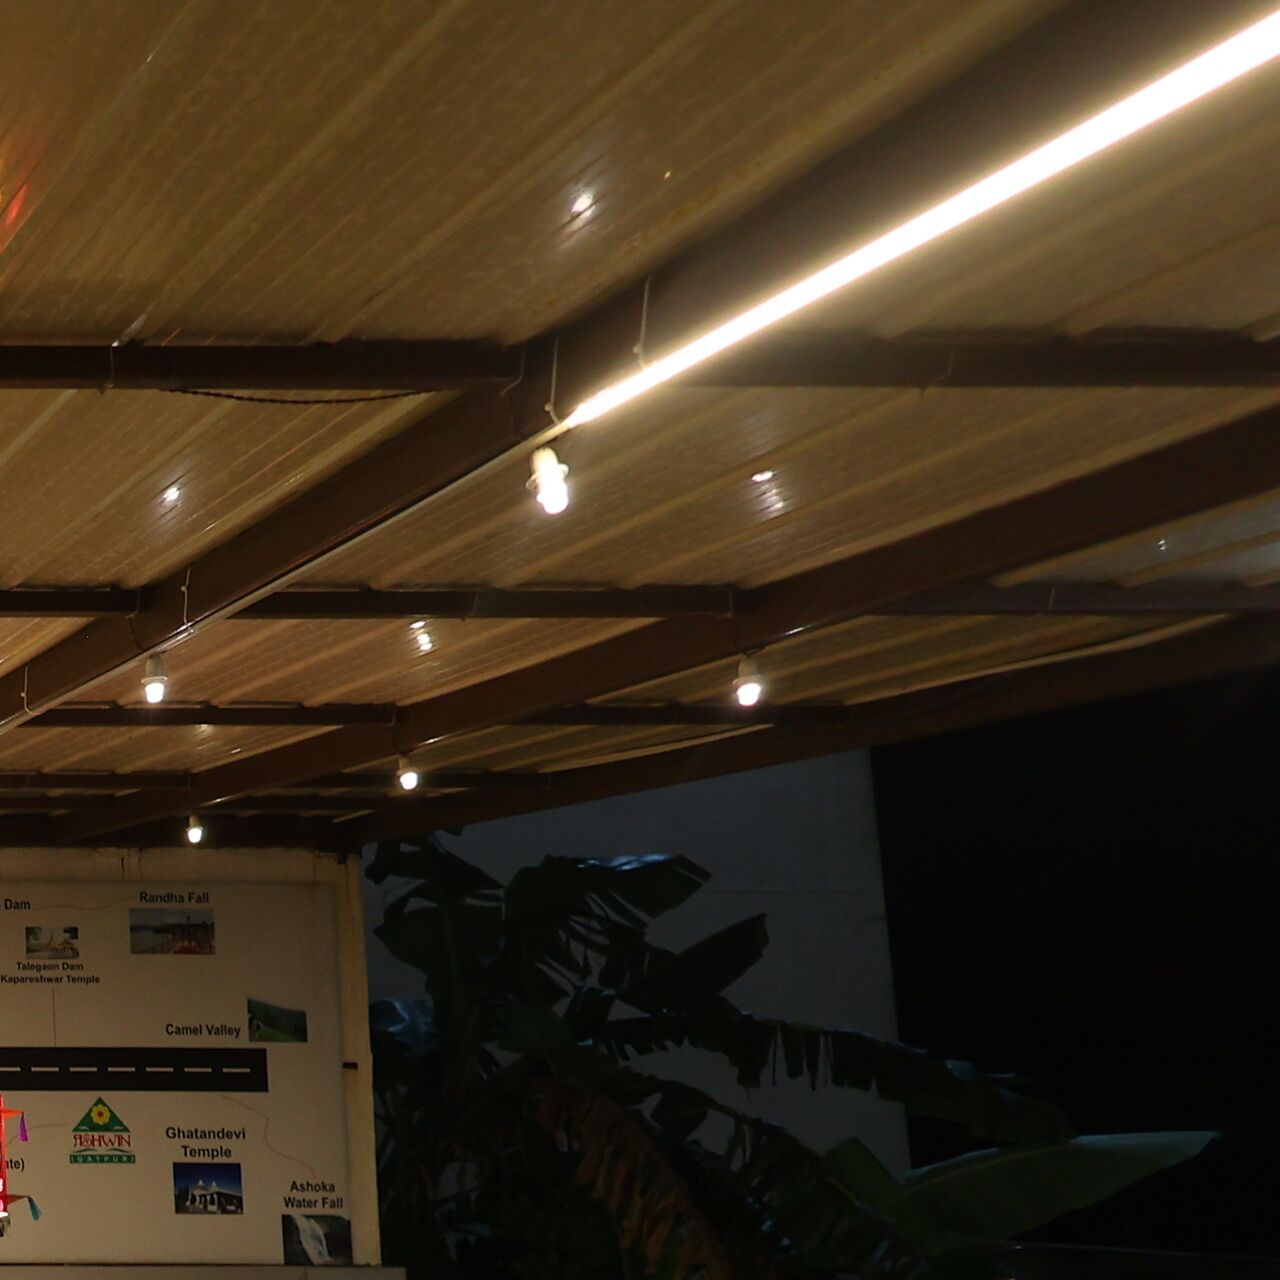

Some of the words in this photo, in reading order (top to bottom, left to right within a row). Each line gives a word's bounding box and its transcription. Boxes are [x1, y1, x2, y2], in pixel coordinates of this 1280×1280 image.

[140, 892, 184, 903] Randha
[188, 892, 208, 903] Fall
[5, 898, 30, 909] Dam
[17, 962, 59, 972] Talegaon
[62, 962, 83, 970] Dam
[1, 975, 63, 984] Kapareshwar
[67, 975, 99, 984] Temple
[166, 1024, 202, 1035] Camel
[206, 1024, 241, 1038] Valley
[166, 1127, 245, 1139] Ghatandevi
[73, 1134, 130, 1147] ASHWIN
[181, 1145, 231, 1160] Temple
[290, 1181, 335, 1192] Ashoka
[284, 1197, 318, 1208] Water
[322, 1197, 343, 1208] Fall
